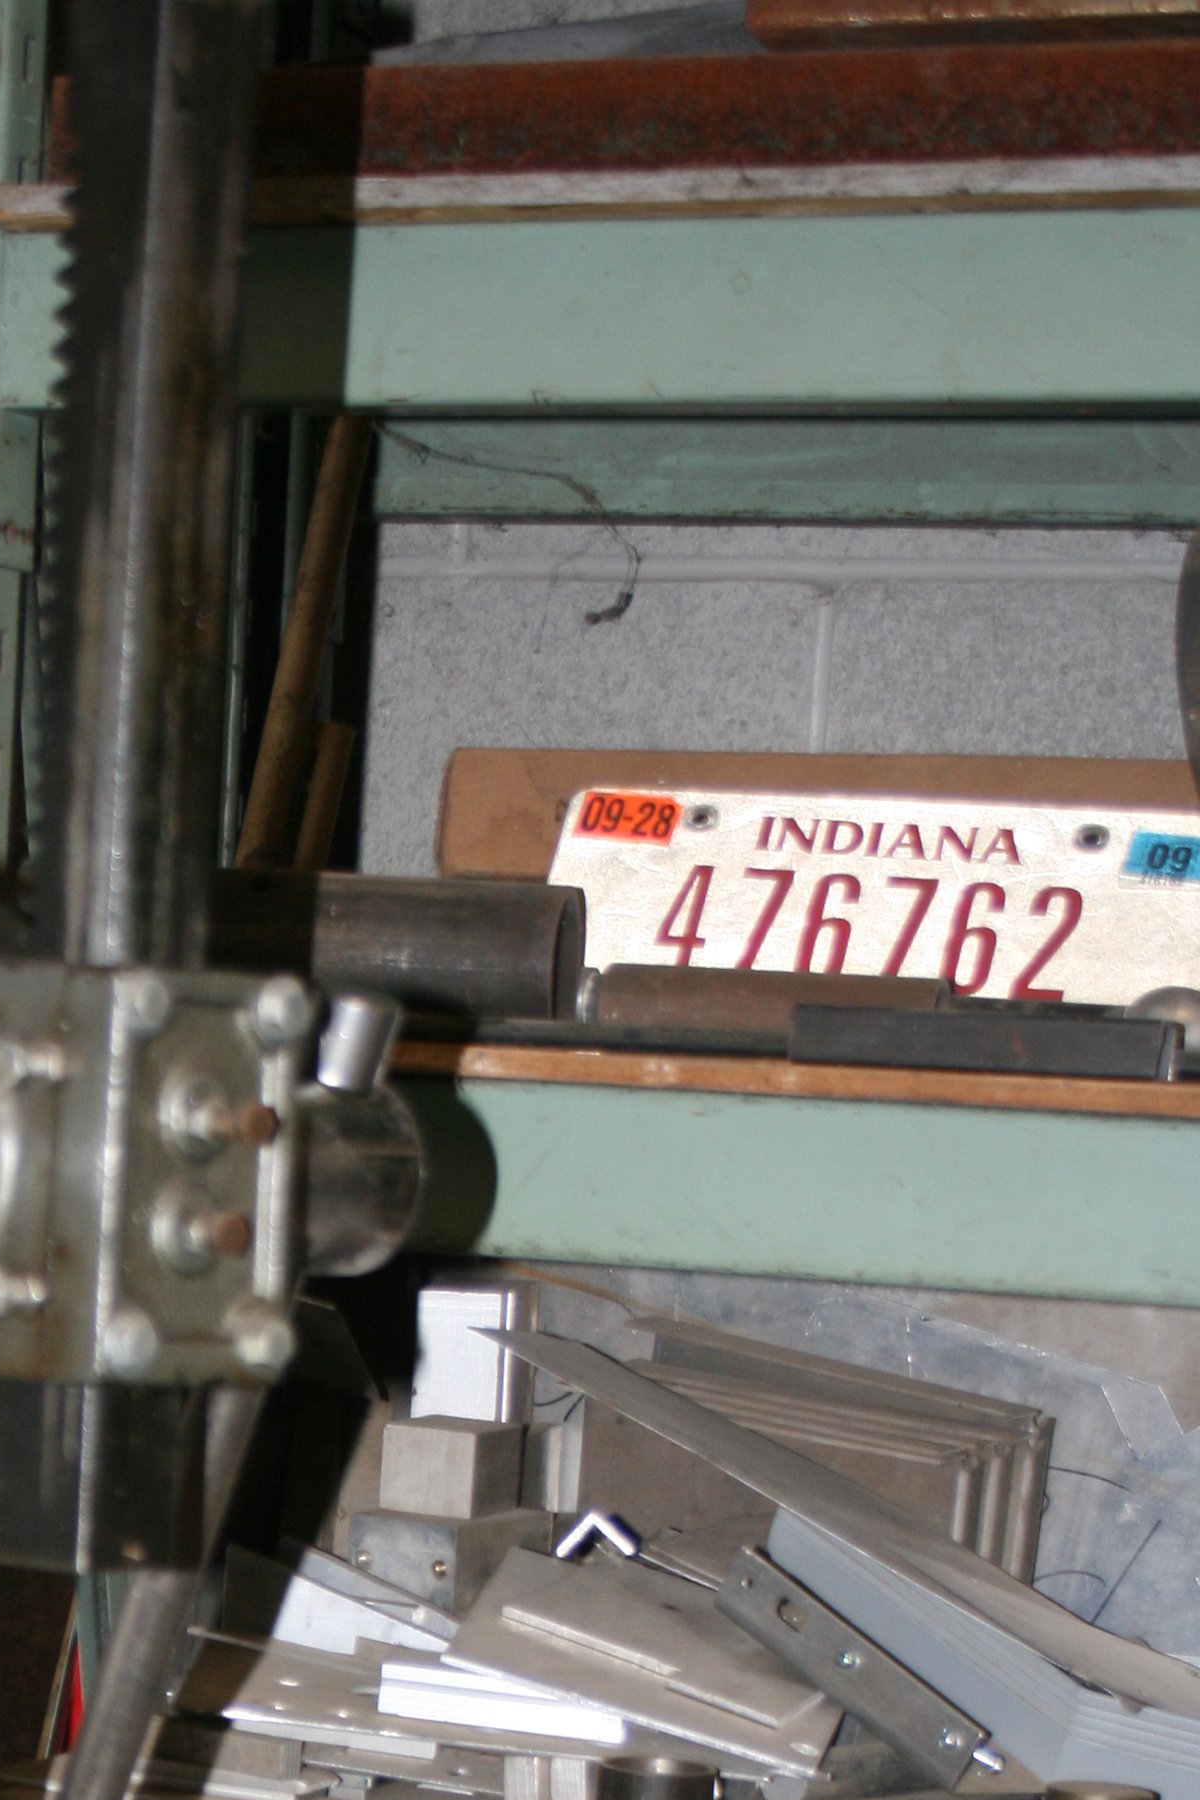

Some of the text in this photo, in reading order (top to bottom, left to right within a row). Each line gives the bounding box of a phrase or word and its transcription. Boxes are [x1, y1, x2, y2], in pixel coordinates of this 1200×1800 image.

[580, 796, 676, 839] 09-28
[753, 815, 1023, 866] INDIANA
[1146, 843, 1193, 872] 09
[653, 864, 1084, 1002] 476762
